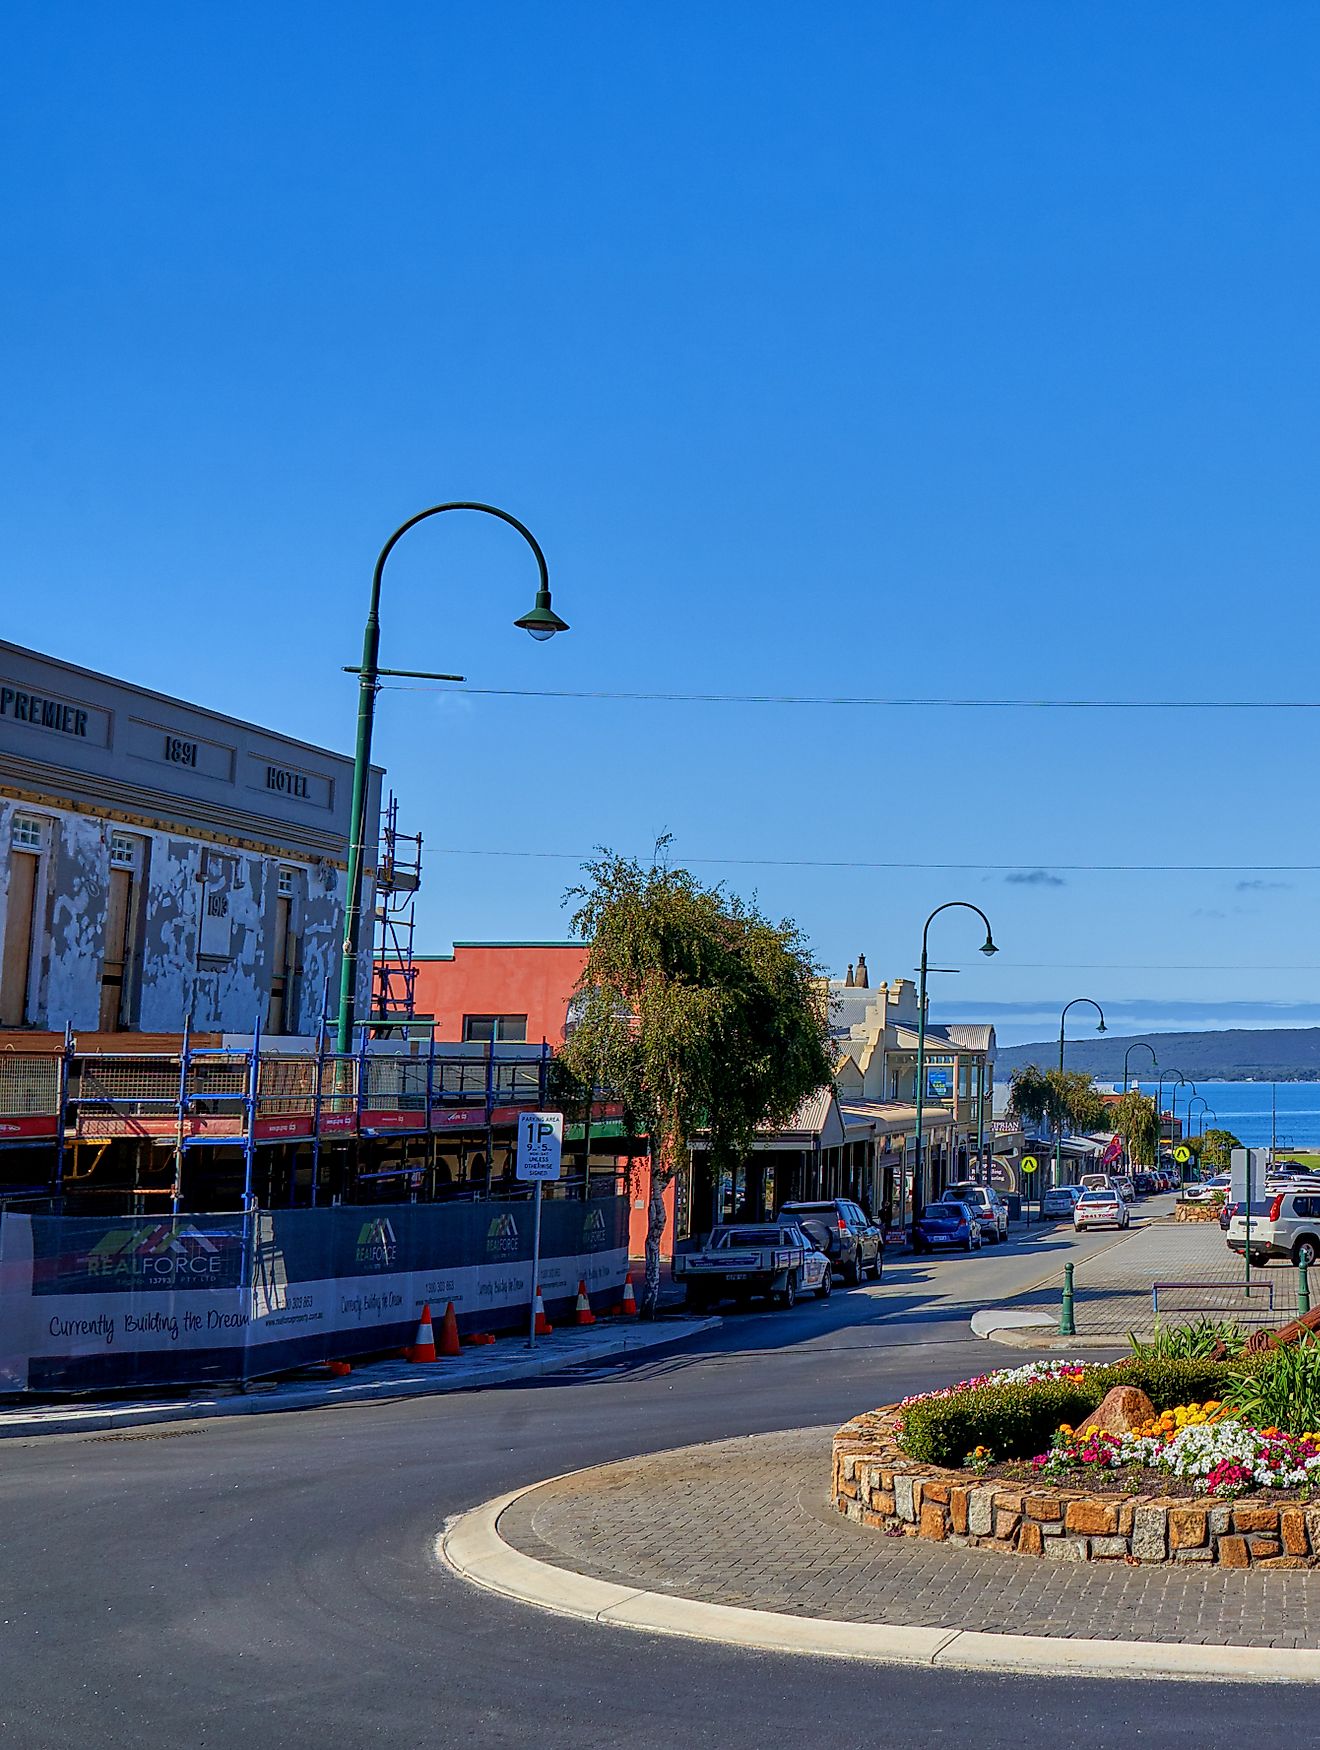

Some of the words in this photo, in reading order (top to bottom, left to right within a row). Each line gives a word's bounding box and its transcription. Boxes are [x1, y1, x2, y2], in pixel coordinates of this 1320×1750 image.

[1, 687, 88, 737] PREMIER
[165, 735, 197, 768] 1891
[266, 766, 311, 799] HOTEL
[207, 895, 228, 918] 1913
[527, 1123, 554, 1144] 1P
[992, 1121, 1019, 1129] IPRIAN
[87, 1256, 222, 1276] REALFORCE
[49, 1313, 115, 1344] Currently
[124, 1312, 179, 1341] Building
[183, 1311, 203, 1329] the
[207, 1309, 250, 1329] Dream
